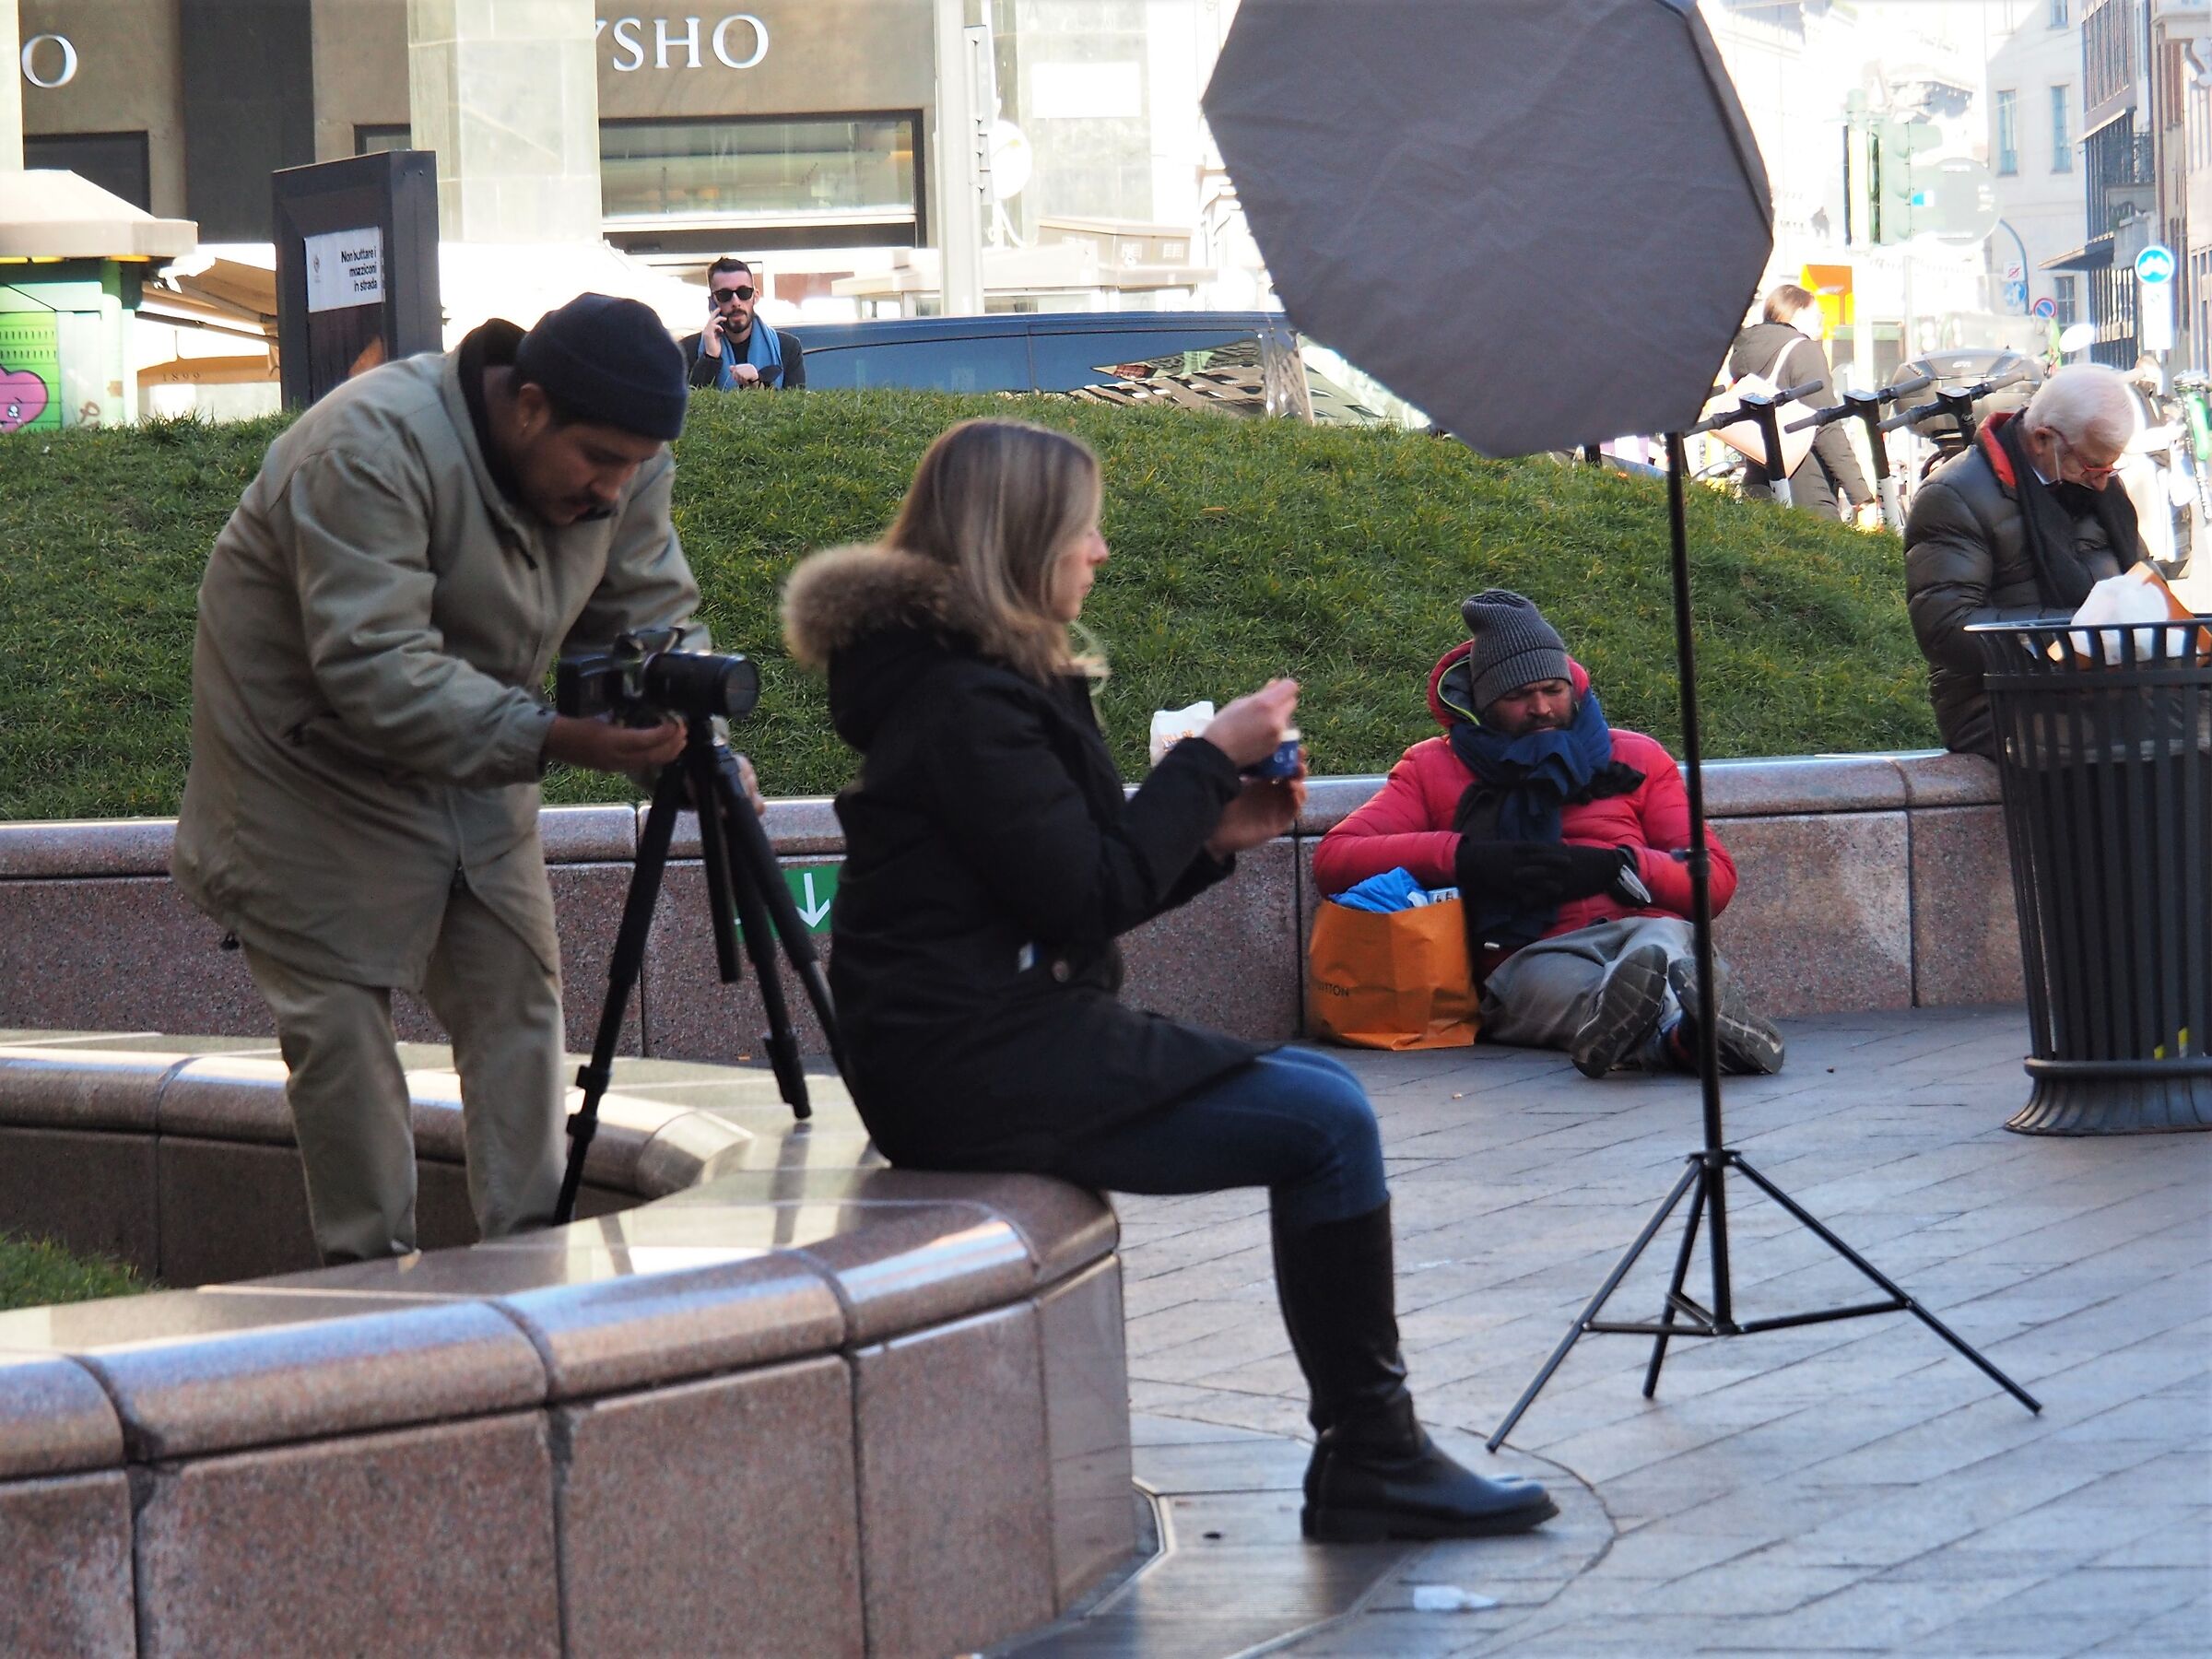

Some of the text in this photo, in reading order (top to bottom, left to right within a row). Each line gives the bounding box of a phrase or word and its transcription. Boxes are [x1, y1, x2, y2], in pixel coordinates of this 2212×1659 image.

[341, 250, 353, 264] Non
[353, 247, 373, 261] buttare
[349, 261, 377, 277] mozziconi
[354, 276, 378, 292] in strada
